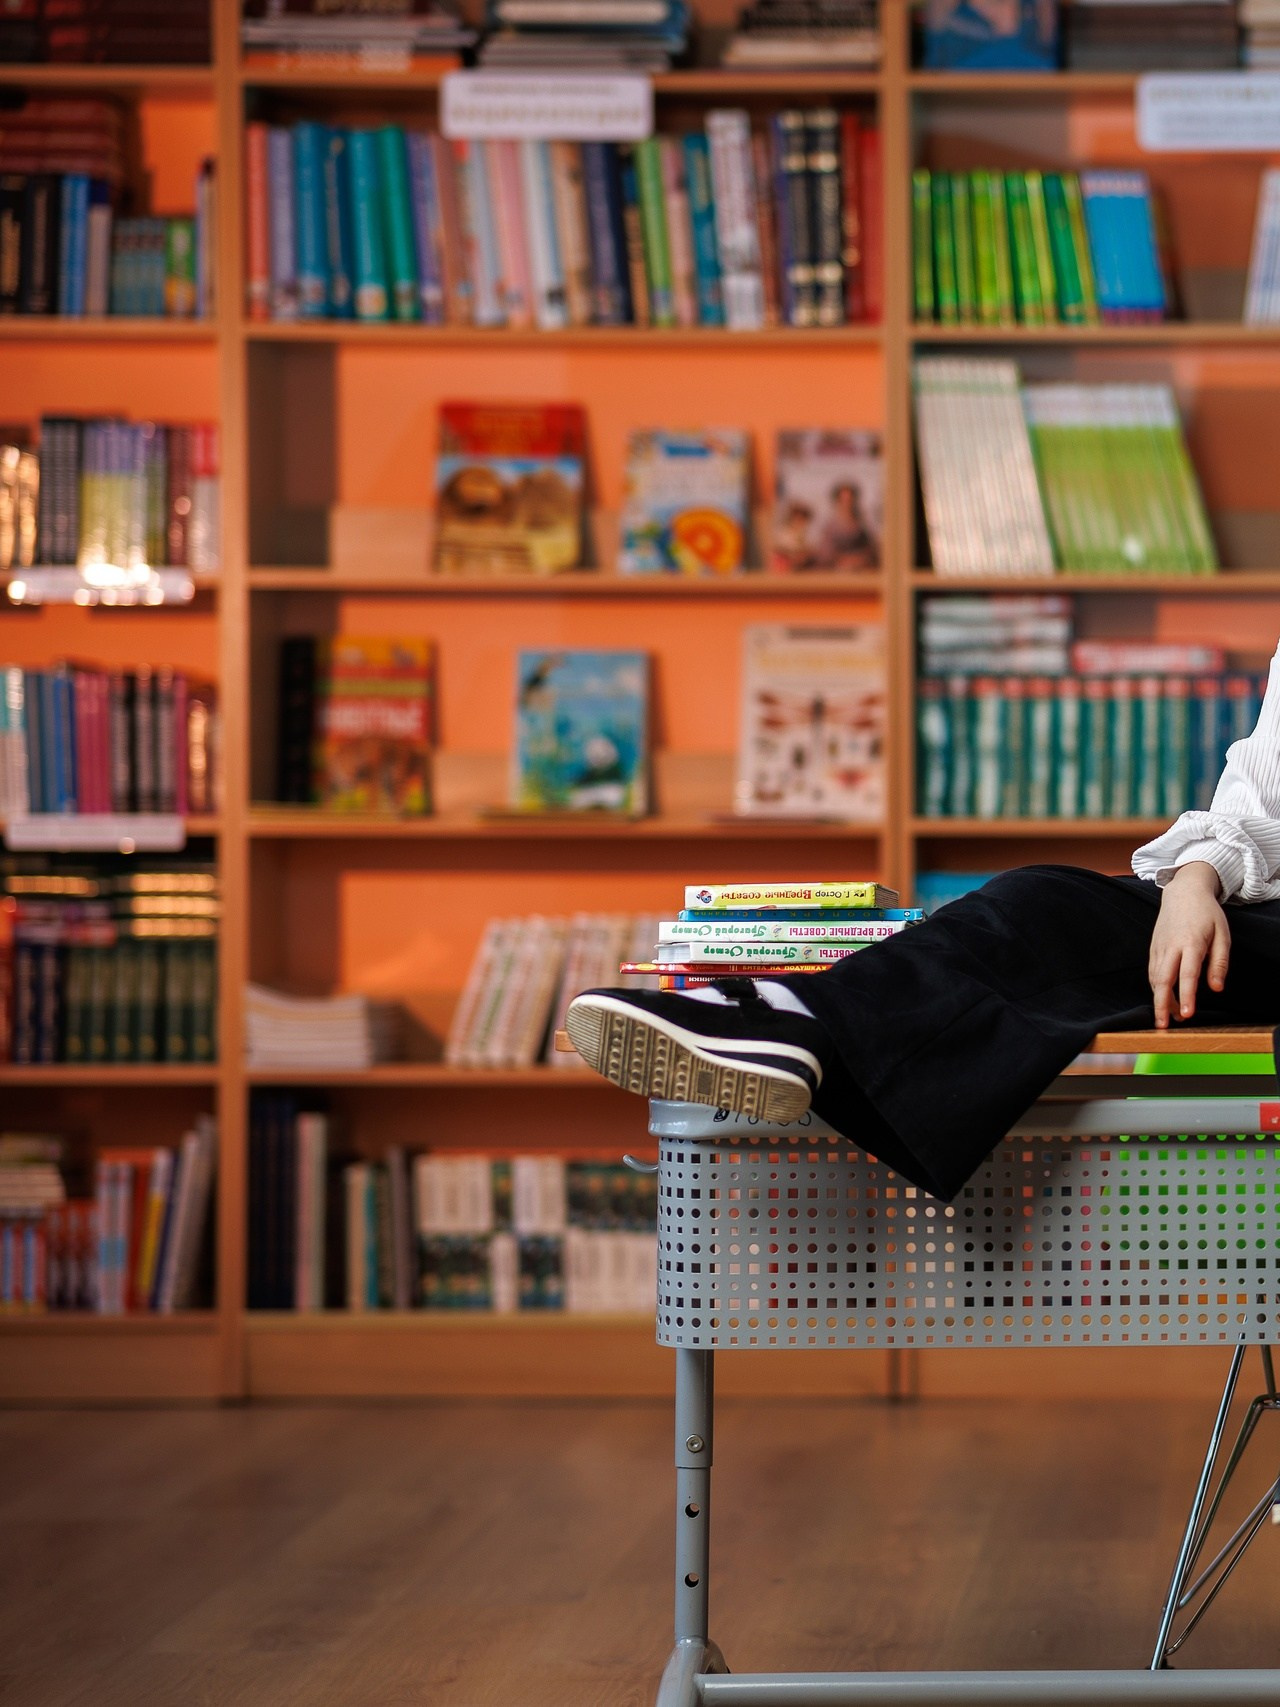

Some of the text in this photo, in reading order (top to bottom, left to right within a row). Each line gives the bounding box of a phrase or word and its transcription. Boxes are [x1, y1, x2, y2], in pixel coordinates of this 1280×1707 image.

[765, 890, 812, 899] Вредные
[815, 890, 842, 899] Остер
[671, 924, 894, 937] ВСЕ ВРЕДНЫЕ СОВЕТЫ Григорий Остер
[703, 944, 744, 957] Остер
[746, 946, 798, 958] Григорий
